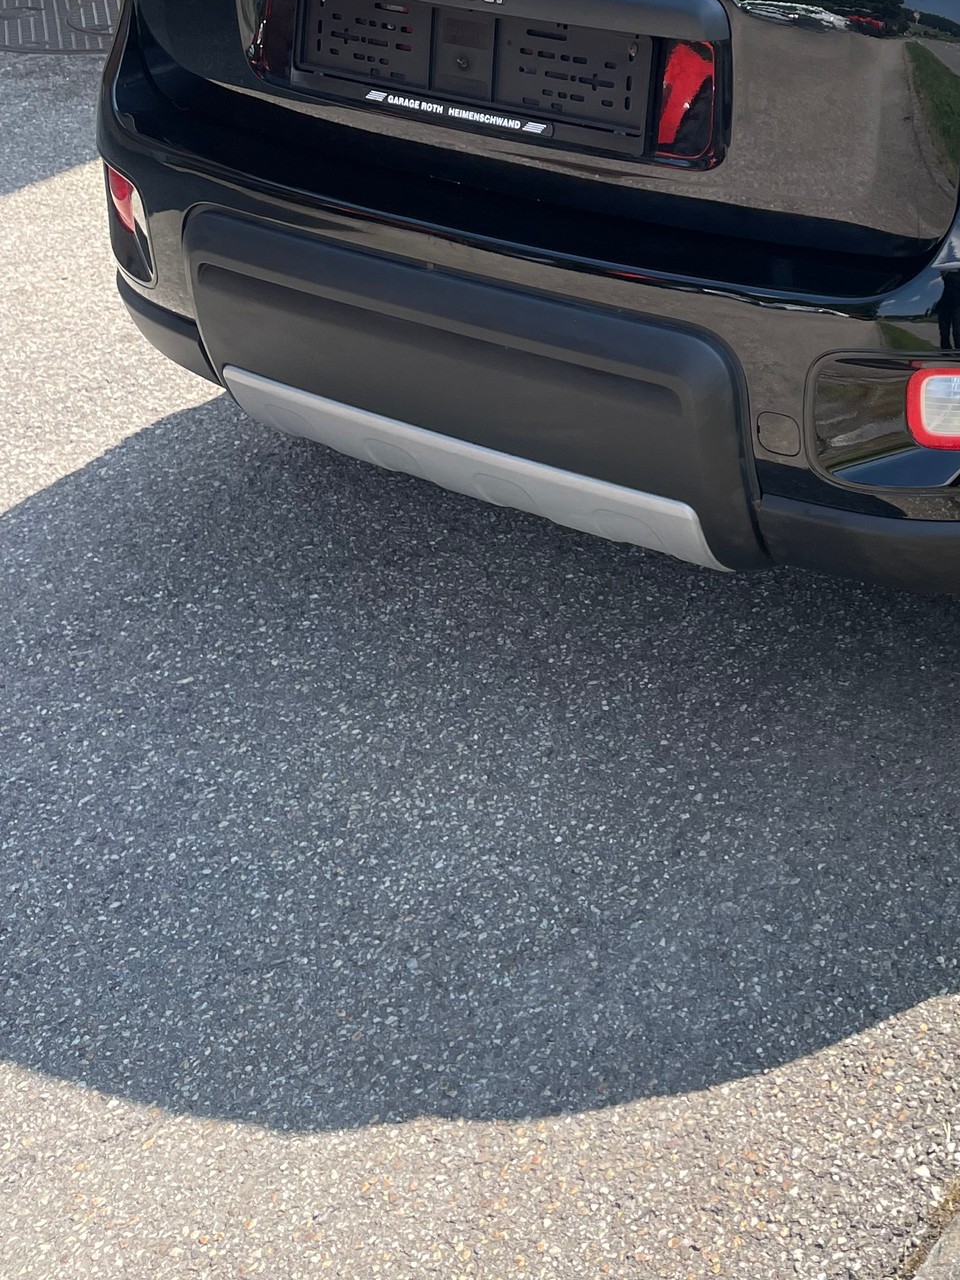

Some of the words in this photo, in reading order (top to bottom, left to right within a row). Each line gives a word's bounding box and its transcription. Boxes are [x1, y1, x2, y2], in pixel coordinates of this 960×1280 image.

[387, 94, 420, 109] GARAGE
[420, 101, 444, 114] ROTH
[448, 107, 521, 130] HEIMENSCHWAND
